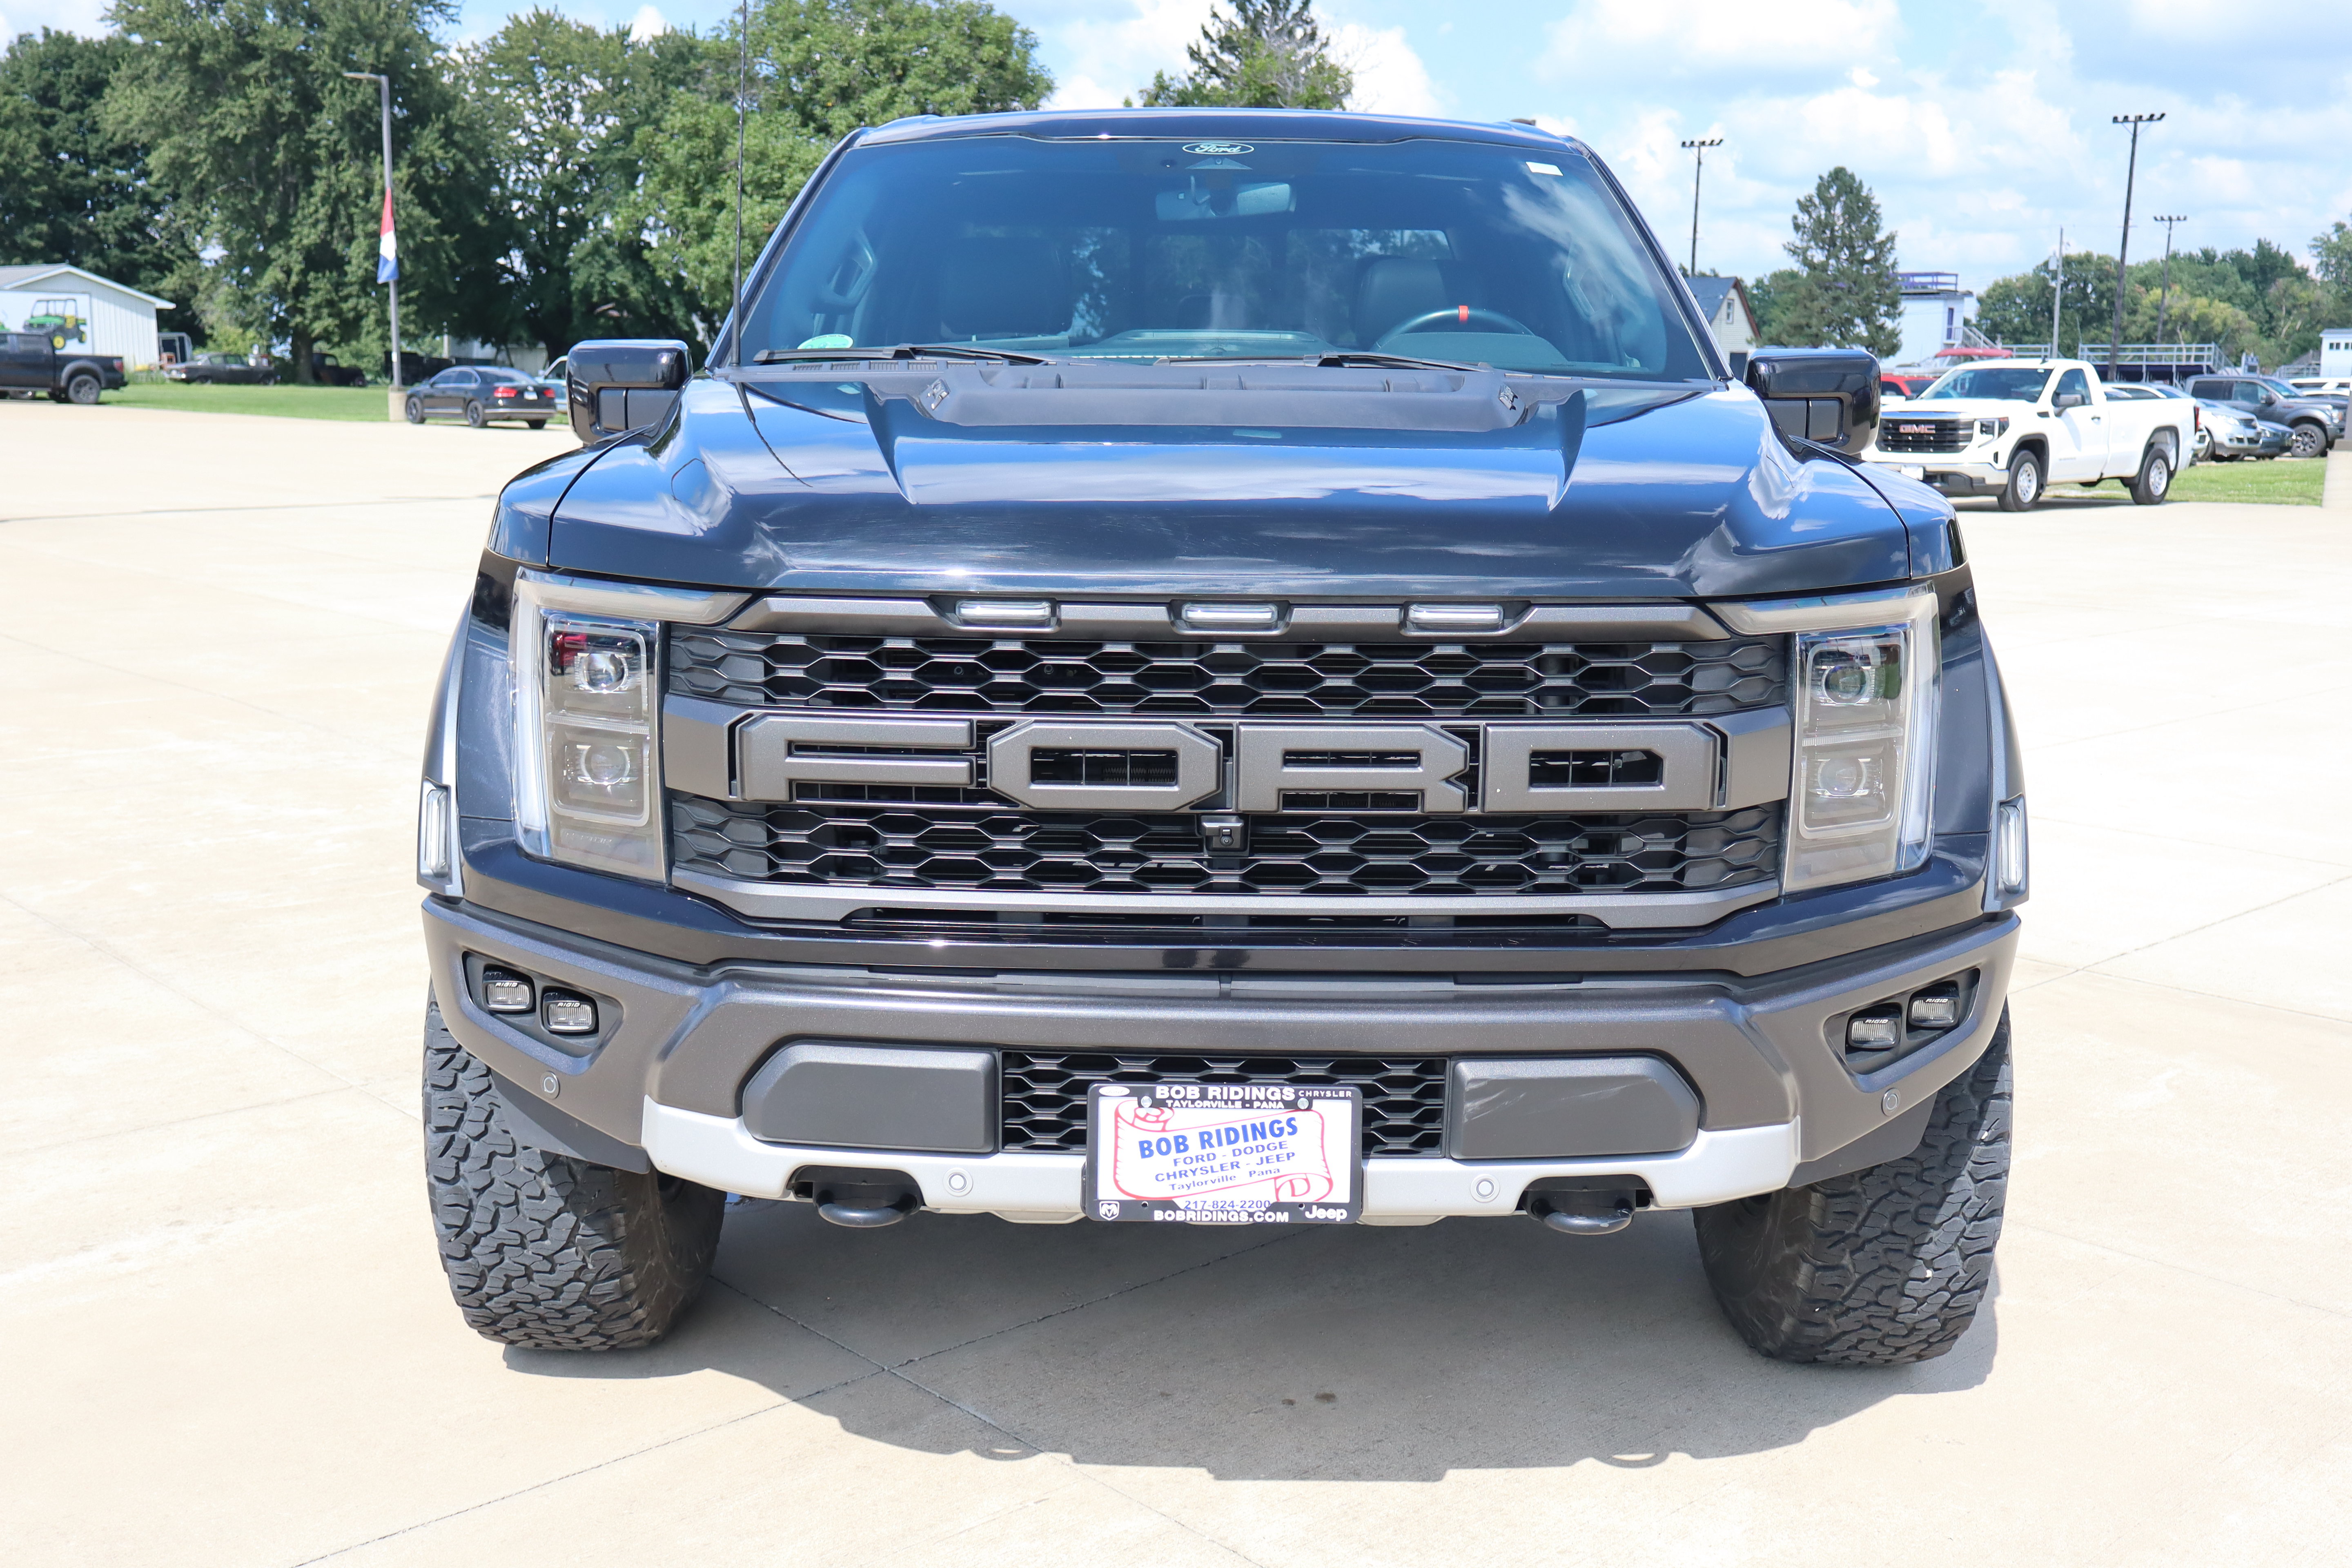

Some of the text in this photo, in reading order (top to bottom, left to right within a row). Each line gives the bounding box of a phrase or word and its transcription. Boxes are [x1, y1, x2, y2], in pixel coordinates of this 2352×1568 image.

[1195, 144, 1241, 153] Ford
[1899, 424, 1936, 433] GMC
[739, 715, 1714, 812] FORD
[1156, 1085, 1296, 1101] BOB RIDINGS
[1166, 1100, 1242, 1109] TAYLORVILLE
[1253, 1101, 1285, 1109] PANA
[1138, 1117, 1298, 1159] BOB RIDINGS
[1174, 1153, 1216, 1167] FORD
[1232, 1140, 1288, 1157] DODGE
[1155, 1161, 1241, 1182] CHRYSLER
[1256, 1152, 1296, 1166] JEEP
[1169, 1168, 1280, 1191] Taylorville Pana
[1184, 1200, 1271, 1210] 217-824-2200
[1154, 1210, 1289, 1223] BOBRIDINGS.COM
[1305, 1205, 1348, 1222] Jeep
